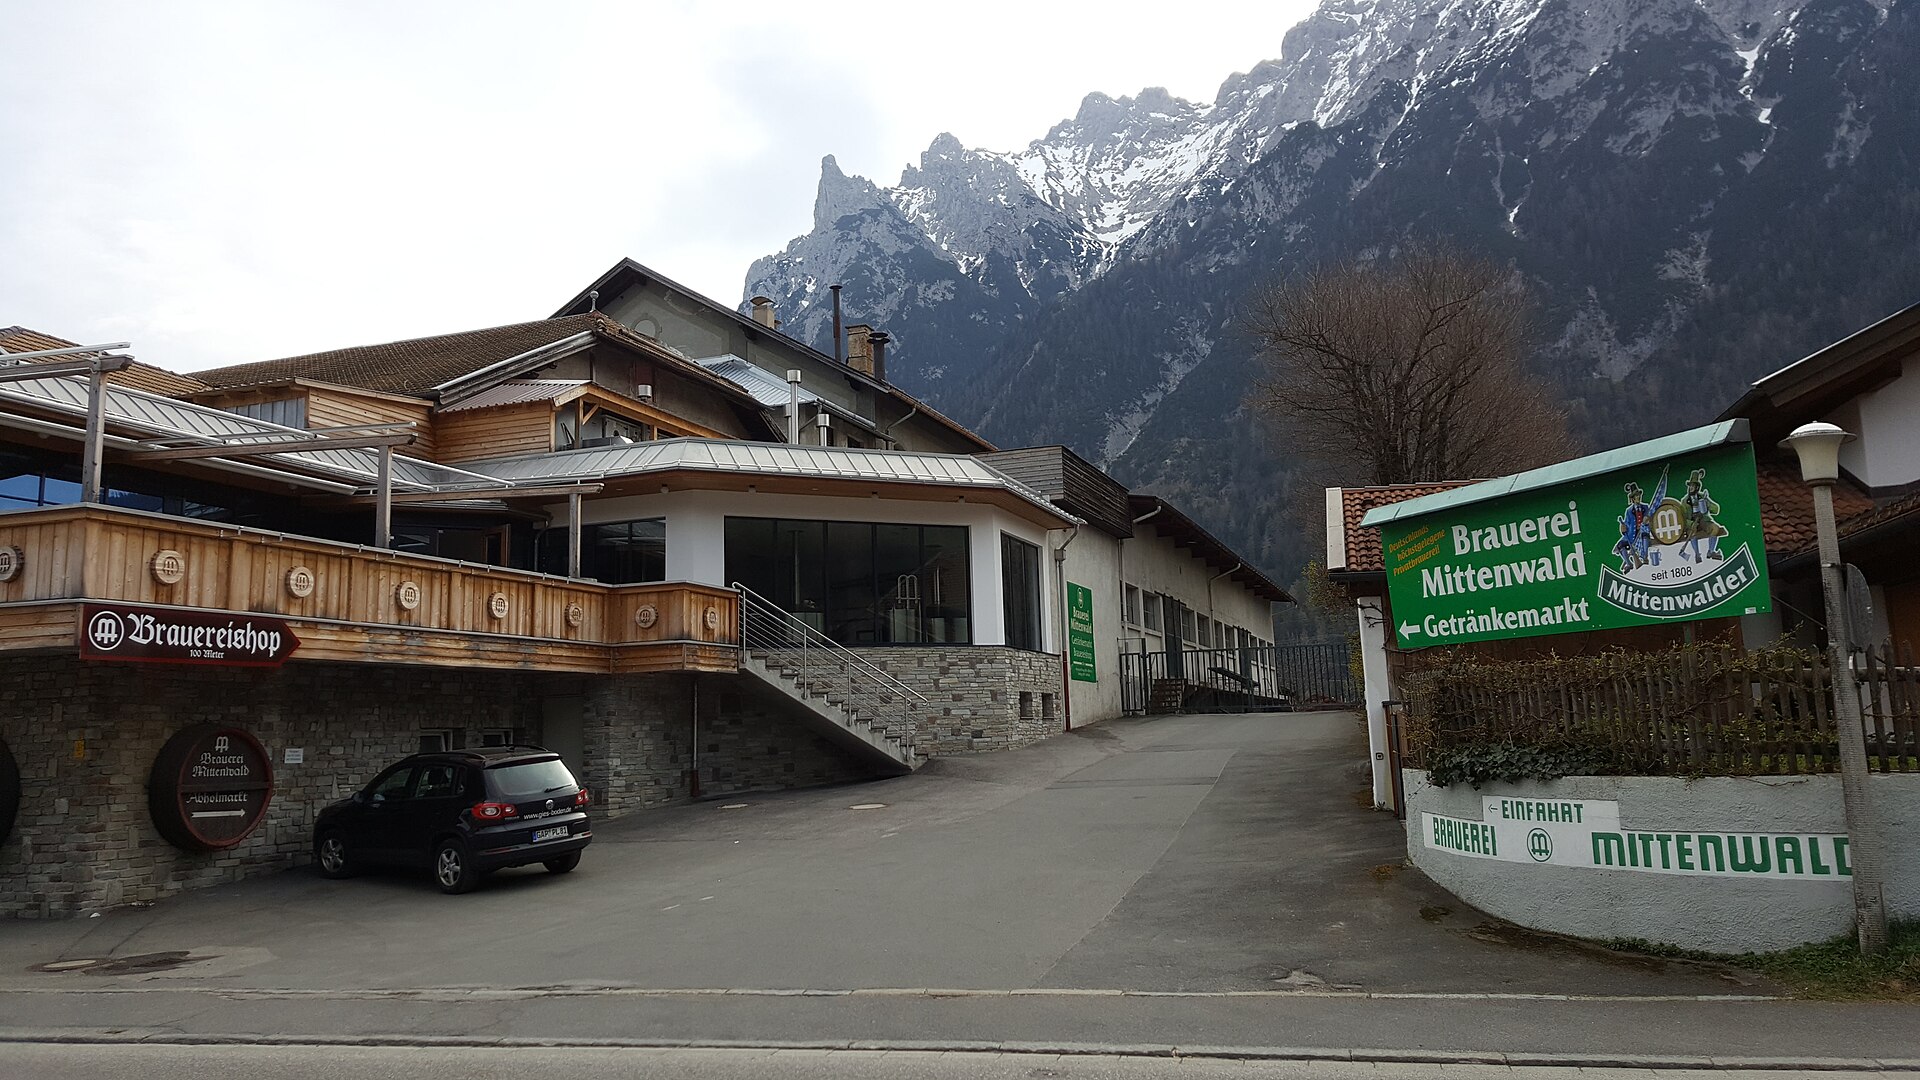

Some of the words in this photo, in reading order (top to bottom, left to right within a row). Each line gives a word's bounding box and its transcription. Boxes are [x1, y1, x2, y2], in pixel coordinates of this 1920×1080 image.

[1389, 524, 1429, 553] Deutschlands
[1452, 500, 1581, 556] Brauerei
[1393, 544, 1440, 577] Privatbrauerei!
[1421, 541, 1587, 598] Mittenwald
[1651, 569, 1668, 581] seit
[1670, 566, 1693, 579] 1808
[1607, 565, 1748, 611] Mittenwalder
[1424, 597, 1590, 637] Getränkemarkt
[127, 613, 281, 657] Brauereishop
[190, 649, 202, 658] 100
[203, 649, 225, 659] Meter
[192, 765, 250, 777] Mittenwald
[200, 752, 244, 764] Brauerei
[186, 792, 248, 804] Abholmarkt
[1502, 800, 1584, 823] EINFAHRT
[1432, 817, 1498, 856] BRAUEREI
